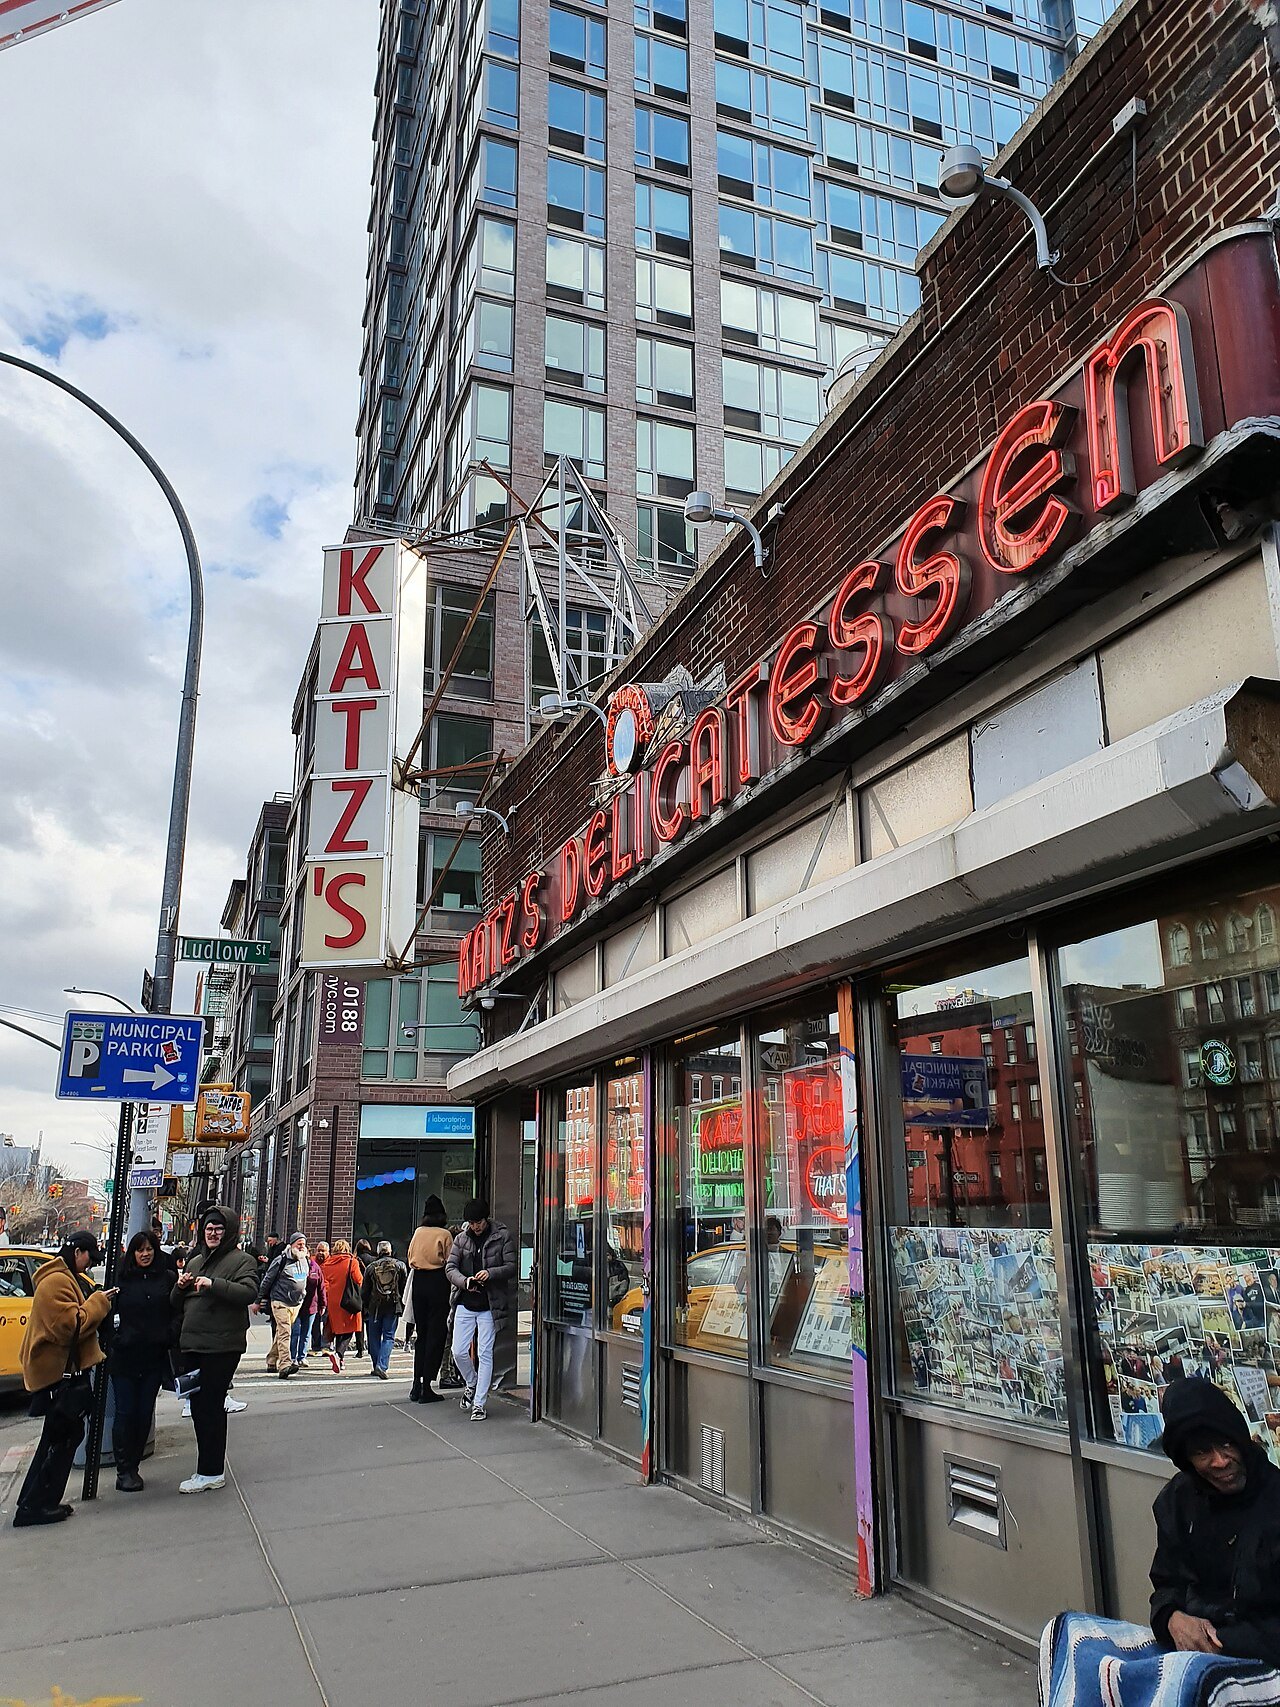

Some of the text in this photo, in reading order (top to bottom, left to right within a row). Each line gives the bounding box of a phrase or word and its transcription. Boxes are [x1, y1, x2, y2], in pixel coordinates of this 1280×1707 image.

[313, 547, 384, 949] KATZ'S
[182, 940, 267, 961] Ludlow St
[341, 981, 360, 1032] .0188
[109, 1023, 196, 1041] MUNICIPAL
[451, 1121, 471, 1132] gelato
